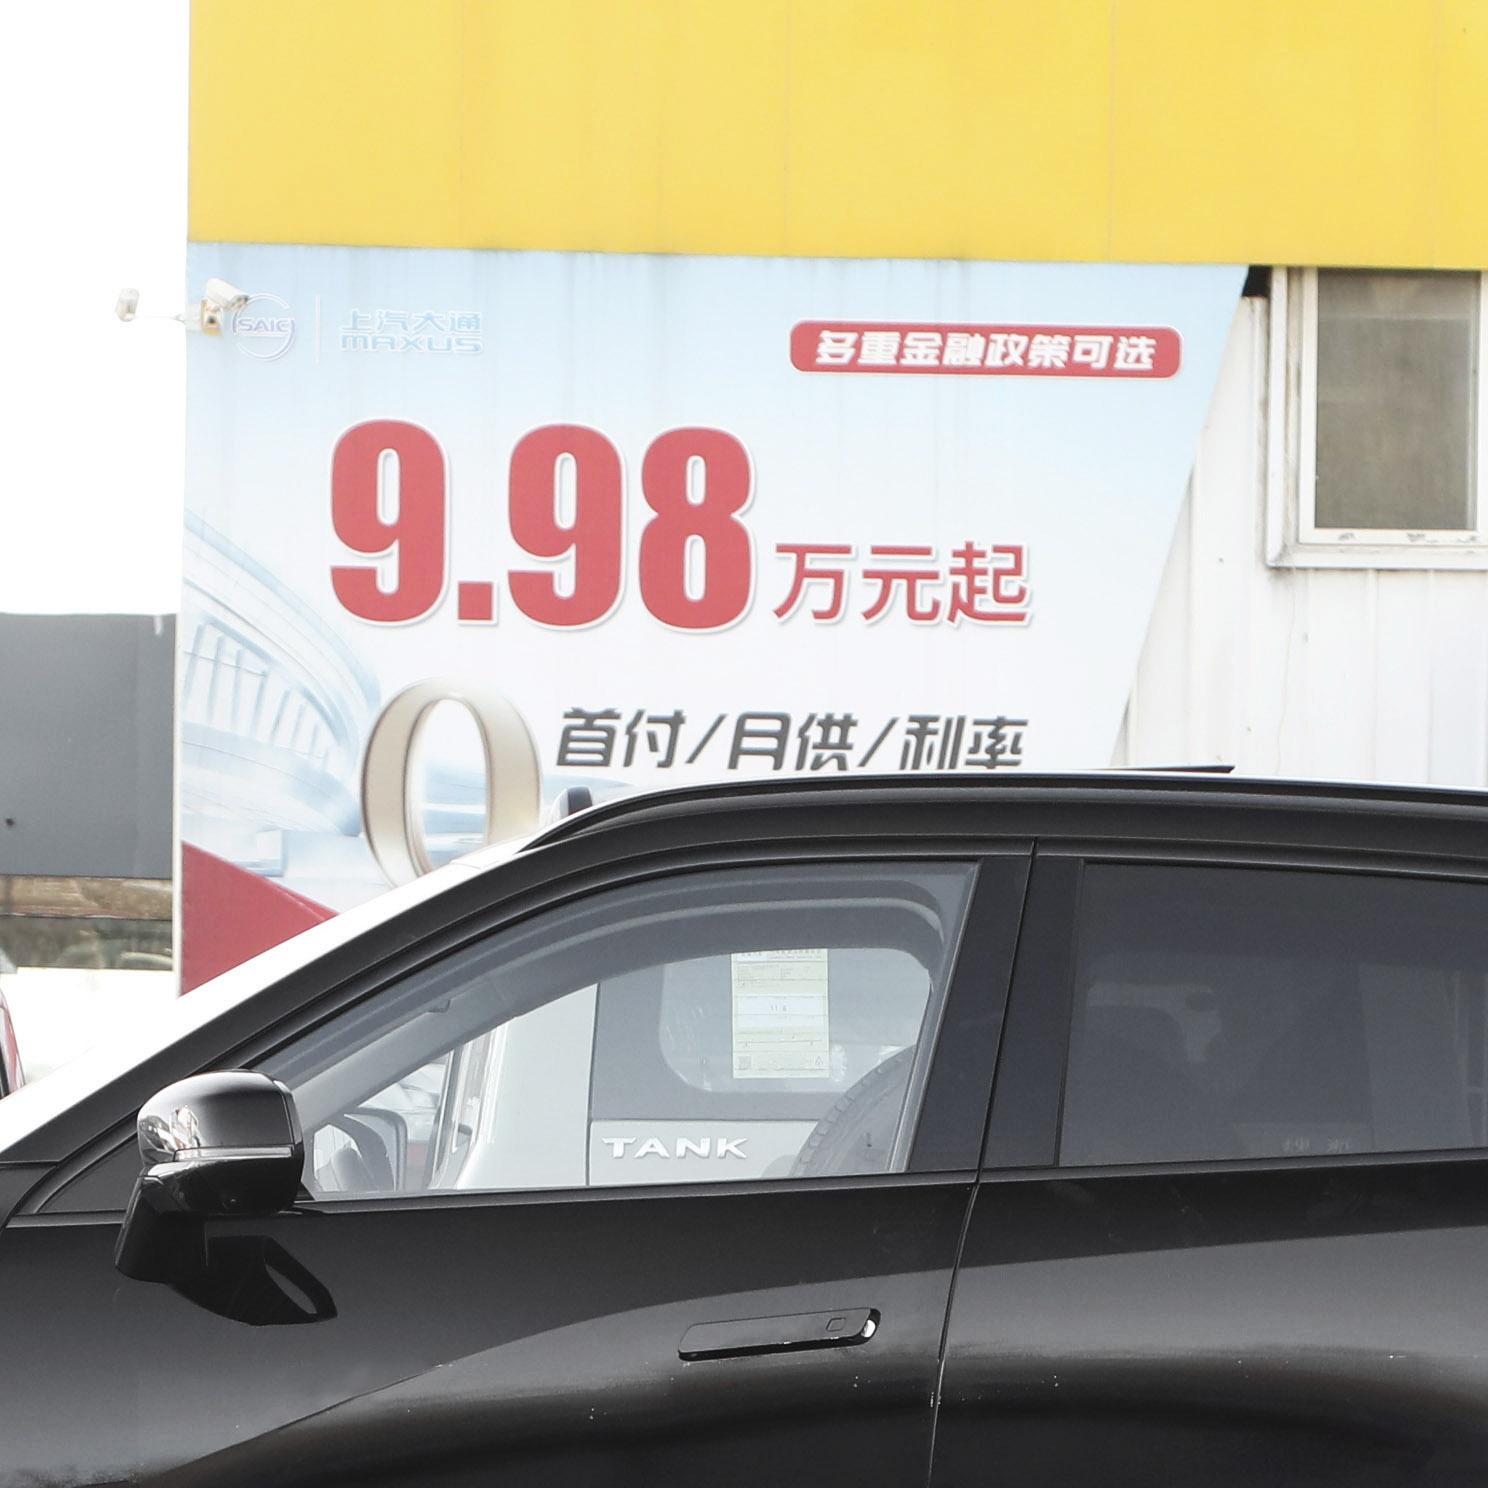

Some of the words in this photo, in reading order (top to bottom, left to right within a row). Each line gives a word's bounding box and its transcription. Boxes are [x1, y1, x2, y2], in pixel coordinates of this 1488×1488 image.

[237, 316, 290, 333] SAIC
[340, 308, 482, 333] 上汽大通
[340, 333, 482, 353] MAXUS
[815, 329, 1157, 371] 多重金融政策可选
[331, 420, 754, 631] 9.98
[556, 707, 1029, 771] 首付/月供/利率
[601, 1136, 750, 1160] TANK
